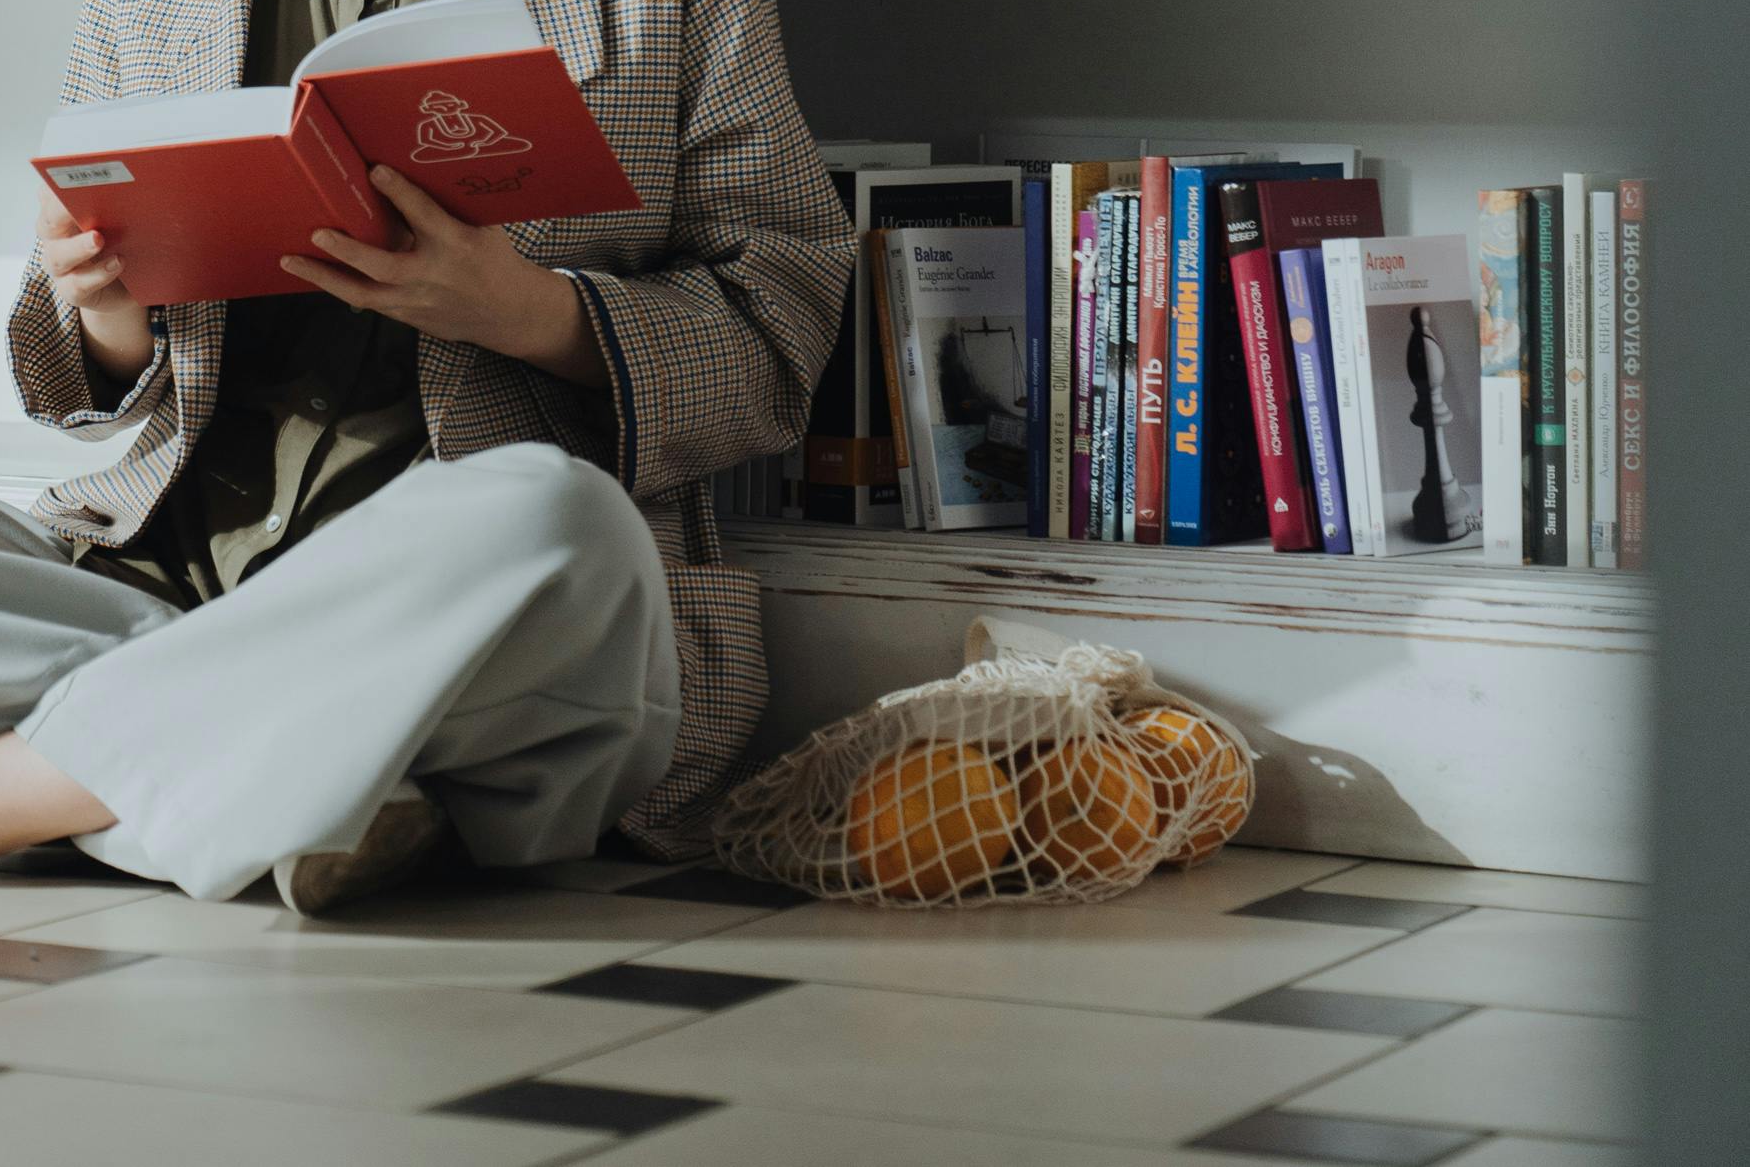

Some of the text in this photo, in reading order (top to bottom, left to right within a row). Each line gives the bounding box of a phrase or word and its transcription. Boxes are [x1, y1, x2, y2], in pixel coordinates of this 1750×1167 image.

[914, 247, 953, 263] Balzac
[1111, 199, 1124, 283] СТАРОДУБЦЕВ
[1154, 216, 1168, 309] Кристина Гросс-Ло
[1177, 239, 1189, 278] ВРЕМЯ
[1187, 185, 1200, 271] АРХЕОЛОГИИ
[1226, 219, 1257, 232] МАКС
[1228, 231, 1259, 244] ВЕБЕР
[1290, 214, 1360, 227] МАКС ВЕБЕР
[1365, 251, 1406, 275] Aragon
[917, 265, 995, 286] Eugénie Grandet
[1143, 264, 1154, 298] Майкл
[1538, 201, 1554, 415] К МУСУЛЬМАНСКОМУ ВОПРОСУ
[1124, 198, 1139, 515] КУДА ДМИТРИЙ СТАРОДУБЦЕВ
[1172, 281, 1199, 455] Л. С. КЛЕЙН
[1248, 281, 1284, 456] КОНФУЦИАНСТВО И ДАОСИЗМ
[1595, 230, 1611, 479] Александр Юрченко КНИГА КАМНЕЙ
[1621, 222, 1642, 471] СЕКС И ФИЛОСОФИЯ
[1051, 266, 1069, 514] НИКОЛА КАЙТЕЗ ФИЛОСОФИЯ ЭНТРОПИИ
[1141, 358, 1164, 425] ПУТЬ
[1300, 351, 1335, 517] СЕМЬ СЕКРЕТОВ ВИШНУ
[1570, 397, 1580, 485] Светлана МАХЛИНА
